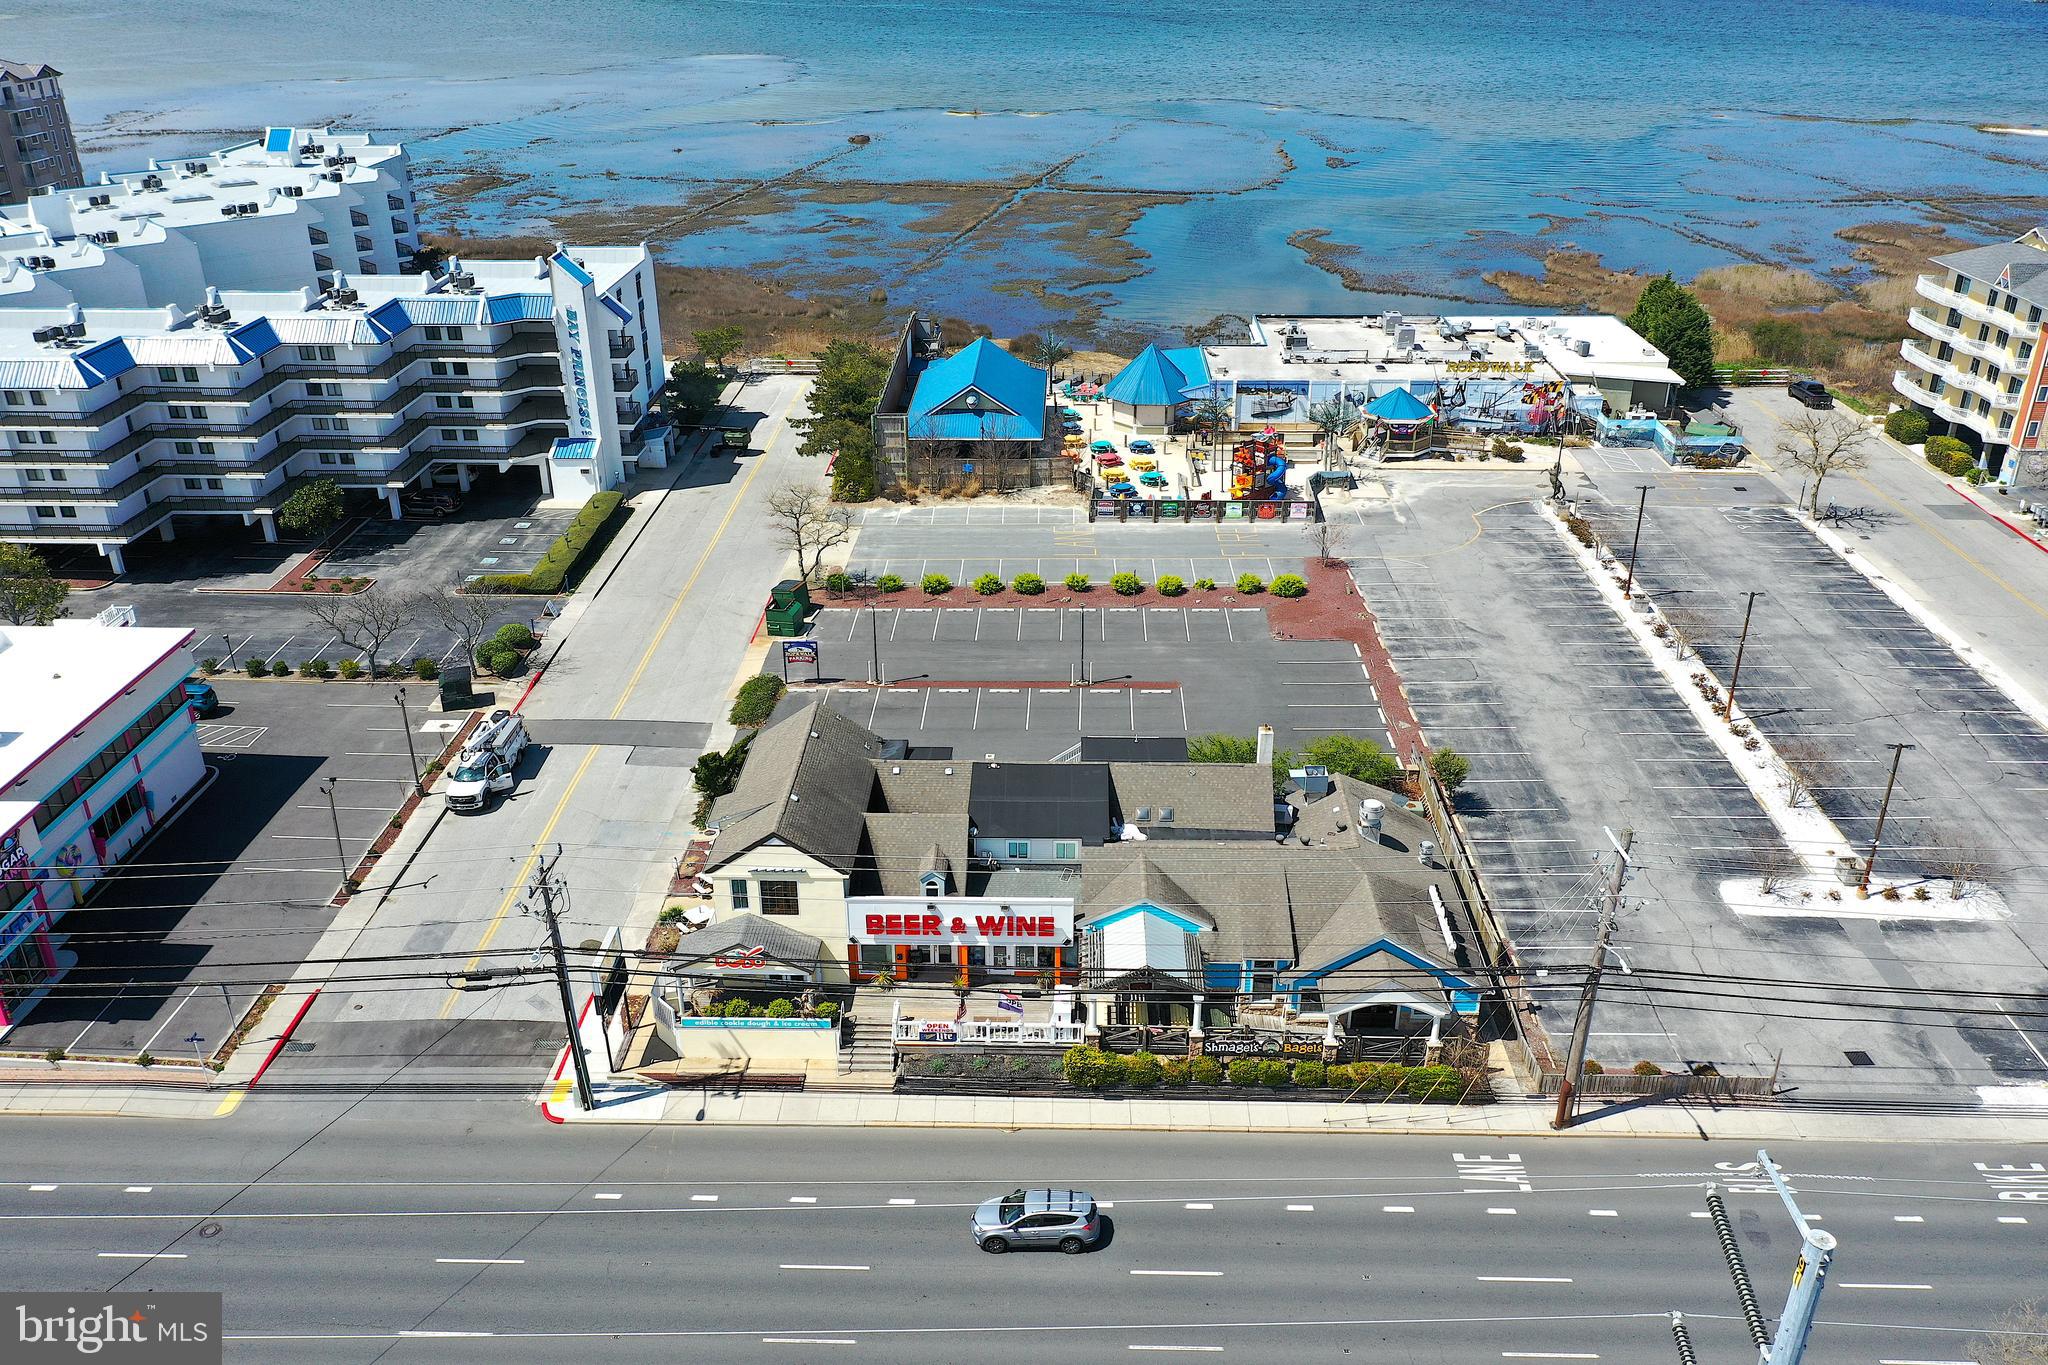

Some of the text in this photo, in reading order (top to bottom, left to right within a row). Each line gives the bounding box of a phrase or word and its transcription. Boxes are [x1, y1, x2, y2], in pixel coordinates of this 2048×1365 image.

[566, 308, 592, 430] BAY PRINCESS
[866, 914, 1055, 937] BEER & WINE
[1283, 1043, 1323, 1054] Bagels
[1452, 1153, 1533, 1193] LANE
